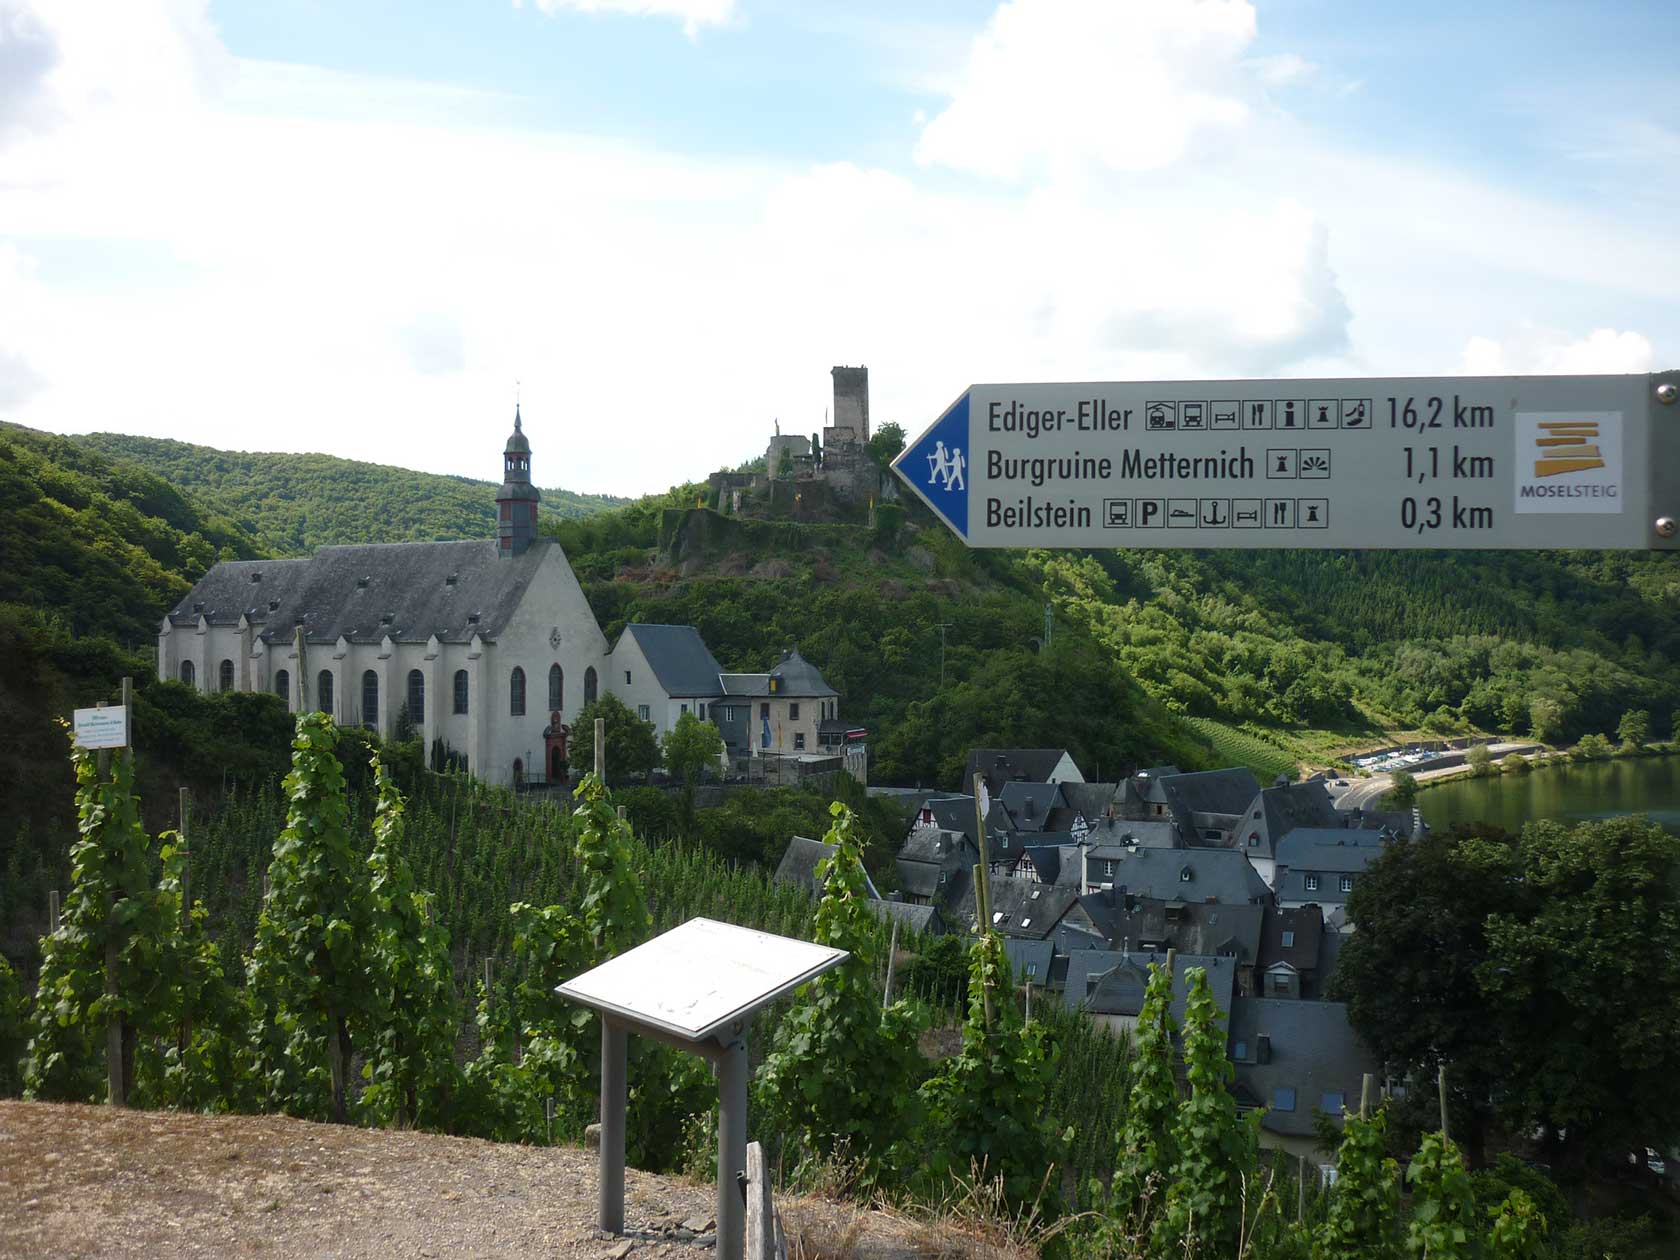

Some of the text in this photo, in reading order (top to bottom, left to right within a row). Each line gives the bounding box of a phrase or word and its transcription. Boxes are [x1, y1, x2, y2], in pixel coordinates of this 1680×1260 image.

[988, 399, 1133, 439] Ediger-Eller
[1387, 397, 1443, 434] 16,2
[1453, 395, 1495, 428] km
[987, 445, 1494, 487] Burgruine Metternich 1,1 km
[1520, 484, 1617, 499] MOSELSTEIG
[986, 496, 1091, 528] Beilstein
[1401, 497, 1442, 534] 0,3
[1453, 495, 1494, 529] km
